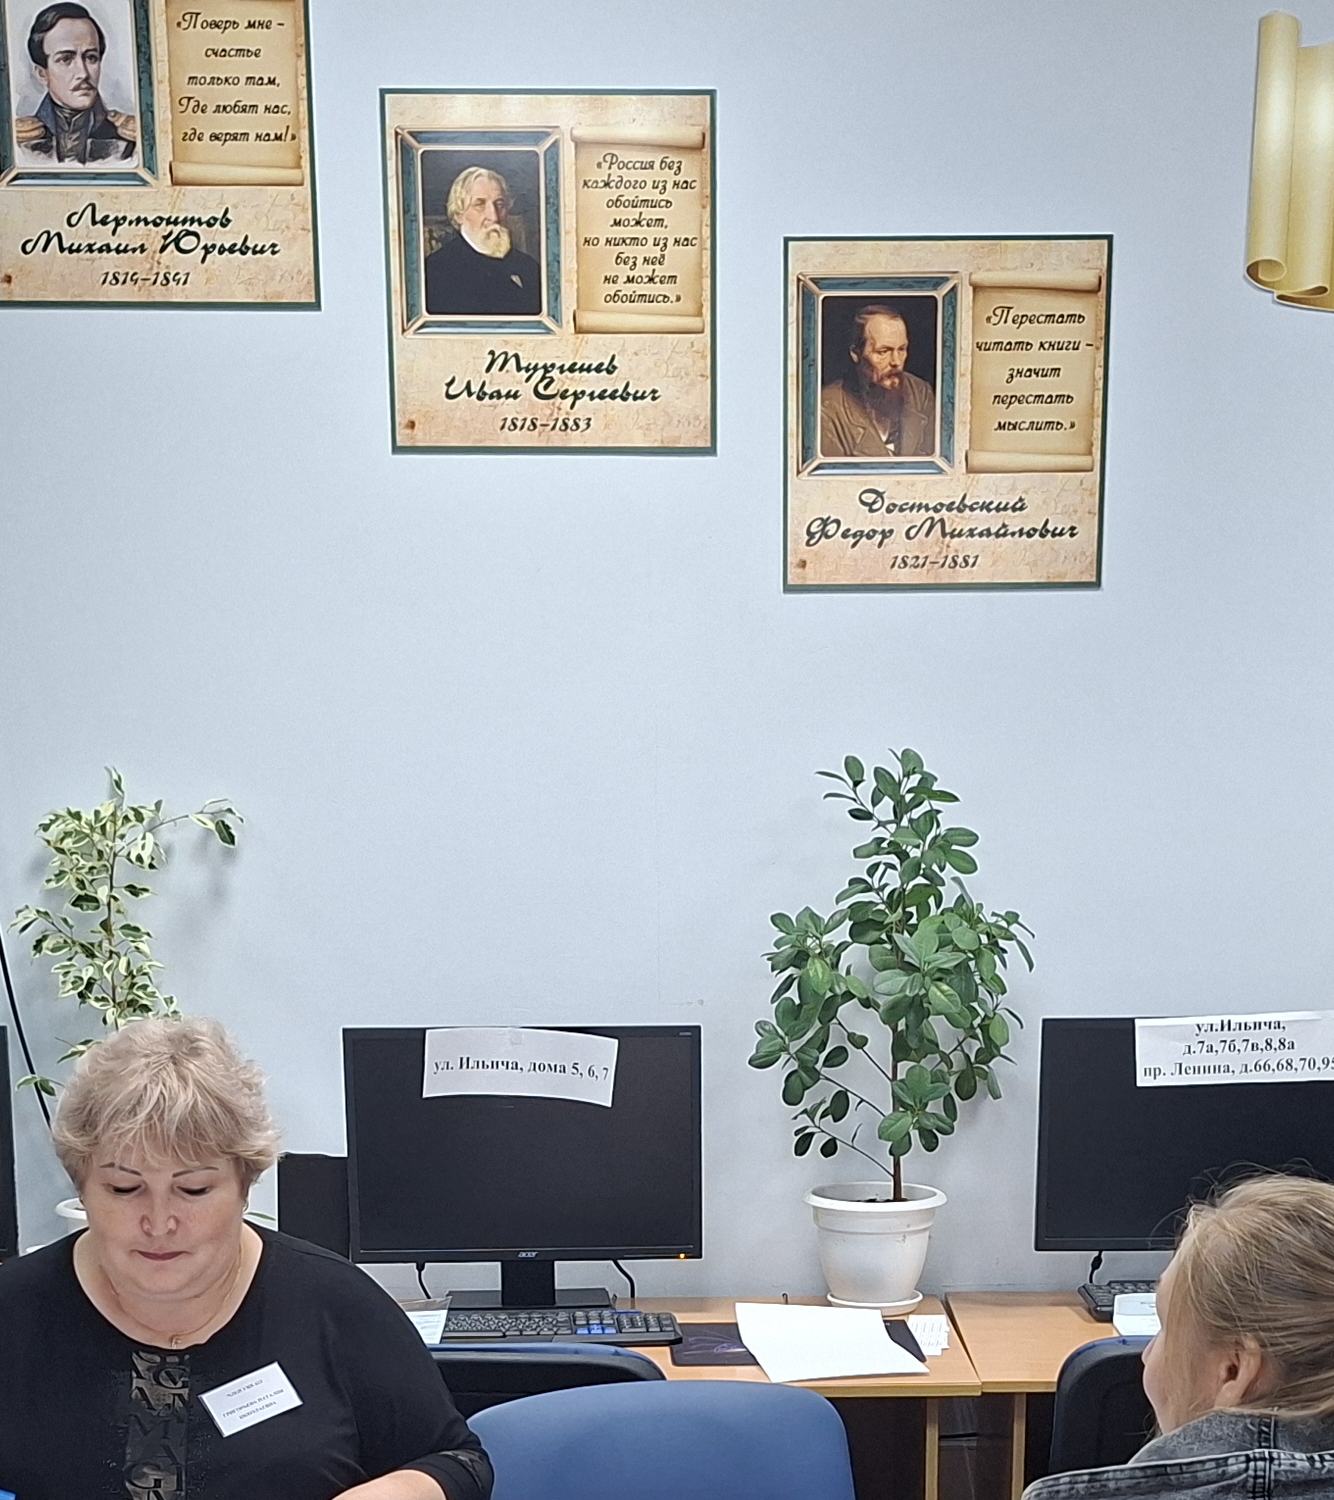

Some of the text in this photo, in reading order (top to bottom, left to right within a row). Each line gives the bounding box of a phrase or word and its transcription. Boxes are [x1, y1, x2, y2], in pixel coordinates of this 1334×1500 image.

[176, 12, 239, 32] «Поверь
[245, 19, 272, 31] мне
[205, 46, 261, 59] счастье
[187, 74, 280, 88] только там,
[178, 96, 291, 117] Где любят нас,
[182, 124, 296, 146] где верят нам!»
[596, 152, 683, 174] «Россия без
[582, 178, 697, 194] каждого из нас
[606, 195, 673, 209] обойтись
[66, 202, 232, 236] Лермонтов
[610, 216, 668, 229] может,
[21, 229, 281, 264] Михаил Юрьевич
[582, 235, 698, 251] но никто из нас
[615, 252, 666, 270] без неё
[603, 272, 678, 285] не может
[604, 289, 682, 304] обойтись.»
[986, 306, 1086, 328] «Перестать
[976, 341, 1033, 352] читать
[1038, 340, 1081, 351] книги
[485, 350, 618, 382] Тургенев
[1006, 366, 1061, 384] значит
[444, 376, 661, 409] Иван Сергеевич
[992, 393, 1075, 409] перестать
[499, 416, 592, 433] 1818-1883
[994, 420, 1076, 432] мыслить.»
[858, 488, 1028, 514] Достоевский
[805, 516, 1079, 549] Федор Михайлович
[889, 554, 980, 570] 1821-1881
[1195, 1018, 1286, 1037] ул.Ильича,
[433, 1056, 609, 1081] ул. Ильича, дома 5, 6, 7
[1143, 1064, 1166, 1079] пр.
[1170, 1061, 1236, 1078] Ленина,
